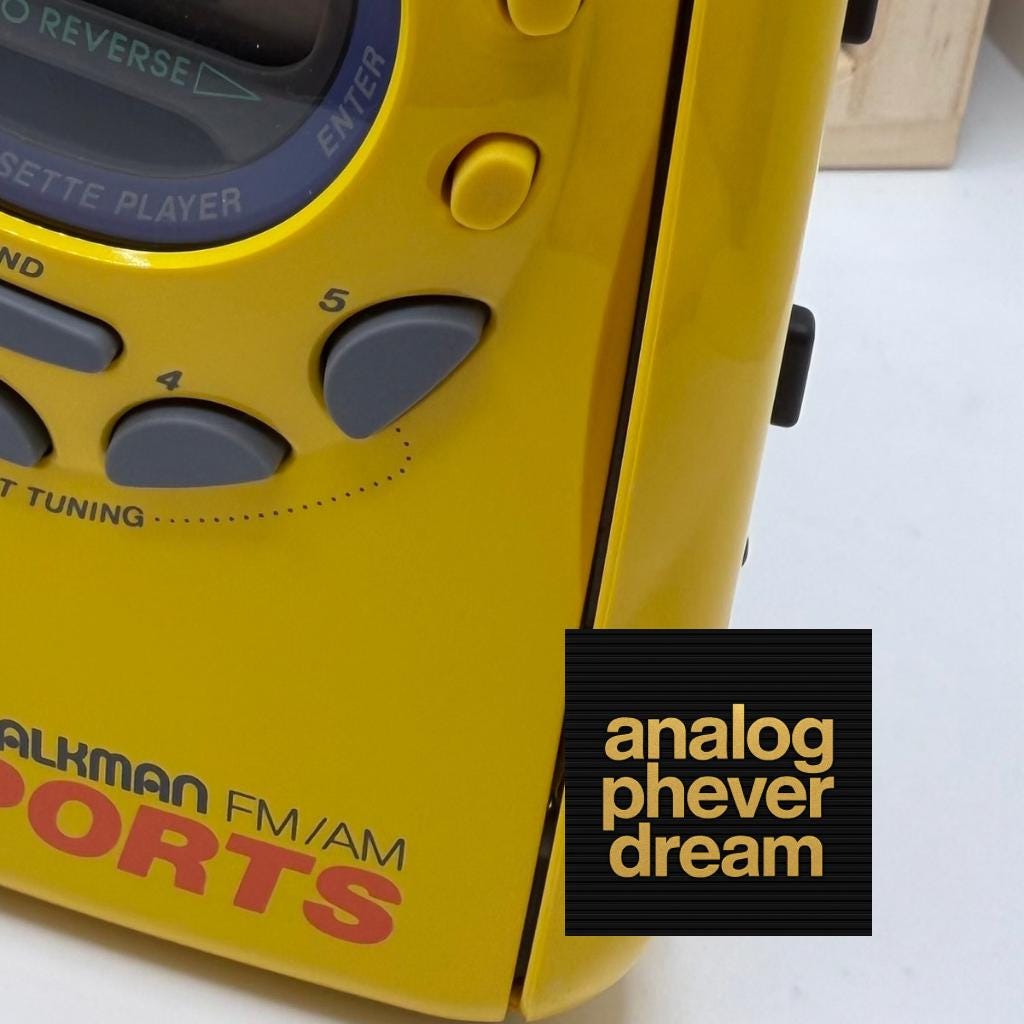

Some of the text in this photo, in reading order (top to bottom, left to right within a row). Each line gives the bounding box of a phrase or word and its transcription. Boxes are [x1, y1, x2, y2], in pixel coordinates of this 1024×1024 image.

[38, 6, 193, 87] REVERSE
[316, 45, 386, 159] ENTER
[113, 187, 242, 224] PLAYER
[319, 288, 350, 314] 5
[155, 369, 184, 393] 4
[26, 486, 146, 528] TUNING
[225, 789, 407, 872] FM/AM
